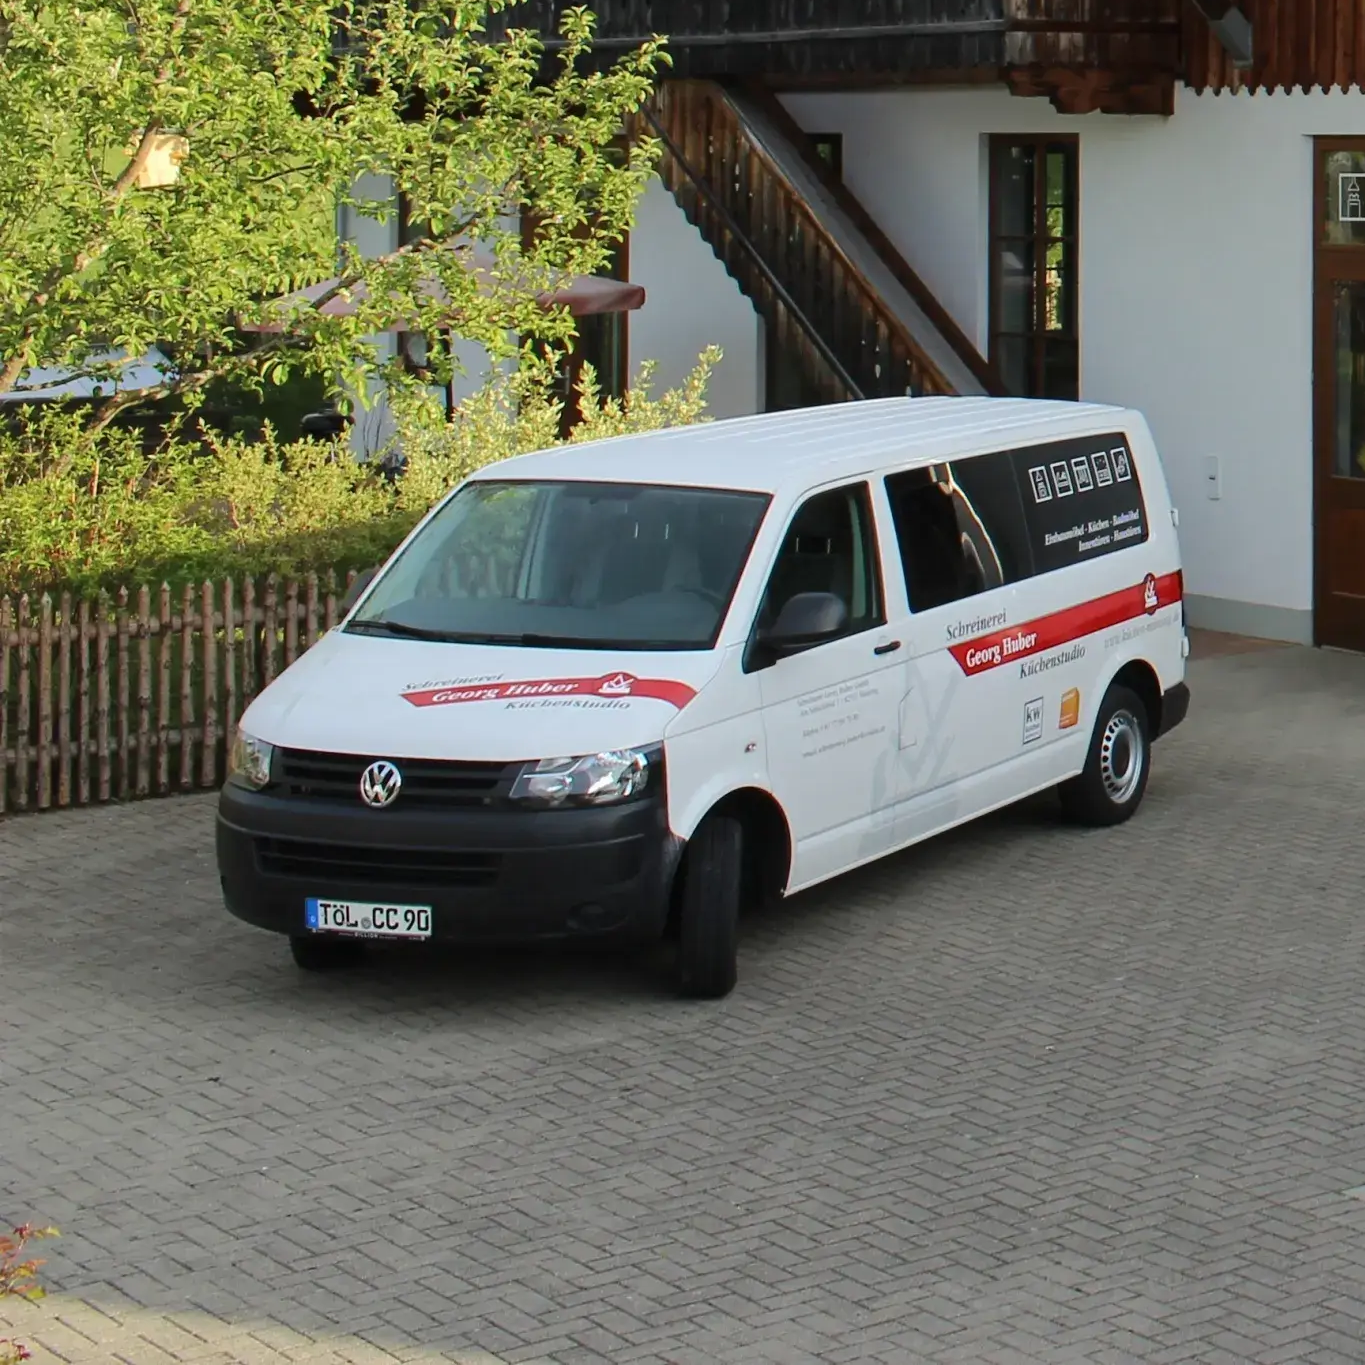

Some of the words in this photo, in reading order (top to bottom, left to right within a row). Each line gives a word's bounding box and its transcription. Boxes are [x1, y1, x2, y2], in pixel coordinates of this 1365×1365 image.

[1087, 519, 1110, 534] Küchen
[946, 607, 1007, 641] Schreinerei
[965, 643, 1001, 669] Georg
[1002, 631, 1037, 657] Huber
[1019, 644, 1086, 680] Küchenstudio
[402, 672, 505, 691] Schreinerei
[431, 686, 500, 703] Georg
[503, 681, 580, 697] Huber
[503, 697, 632, 711] Küchenstudio
[319, 903, 359, 928] TÖL
[372, 907, 400, 930] CC
[404, 909, 430, 932] 90
